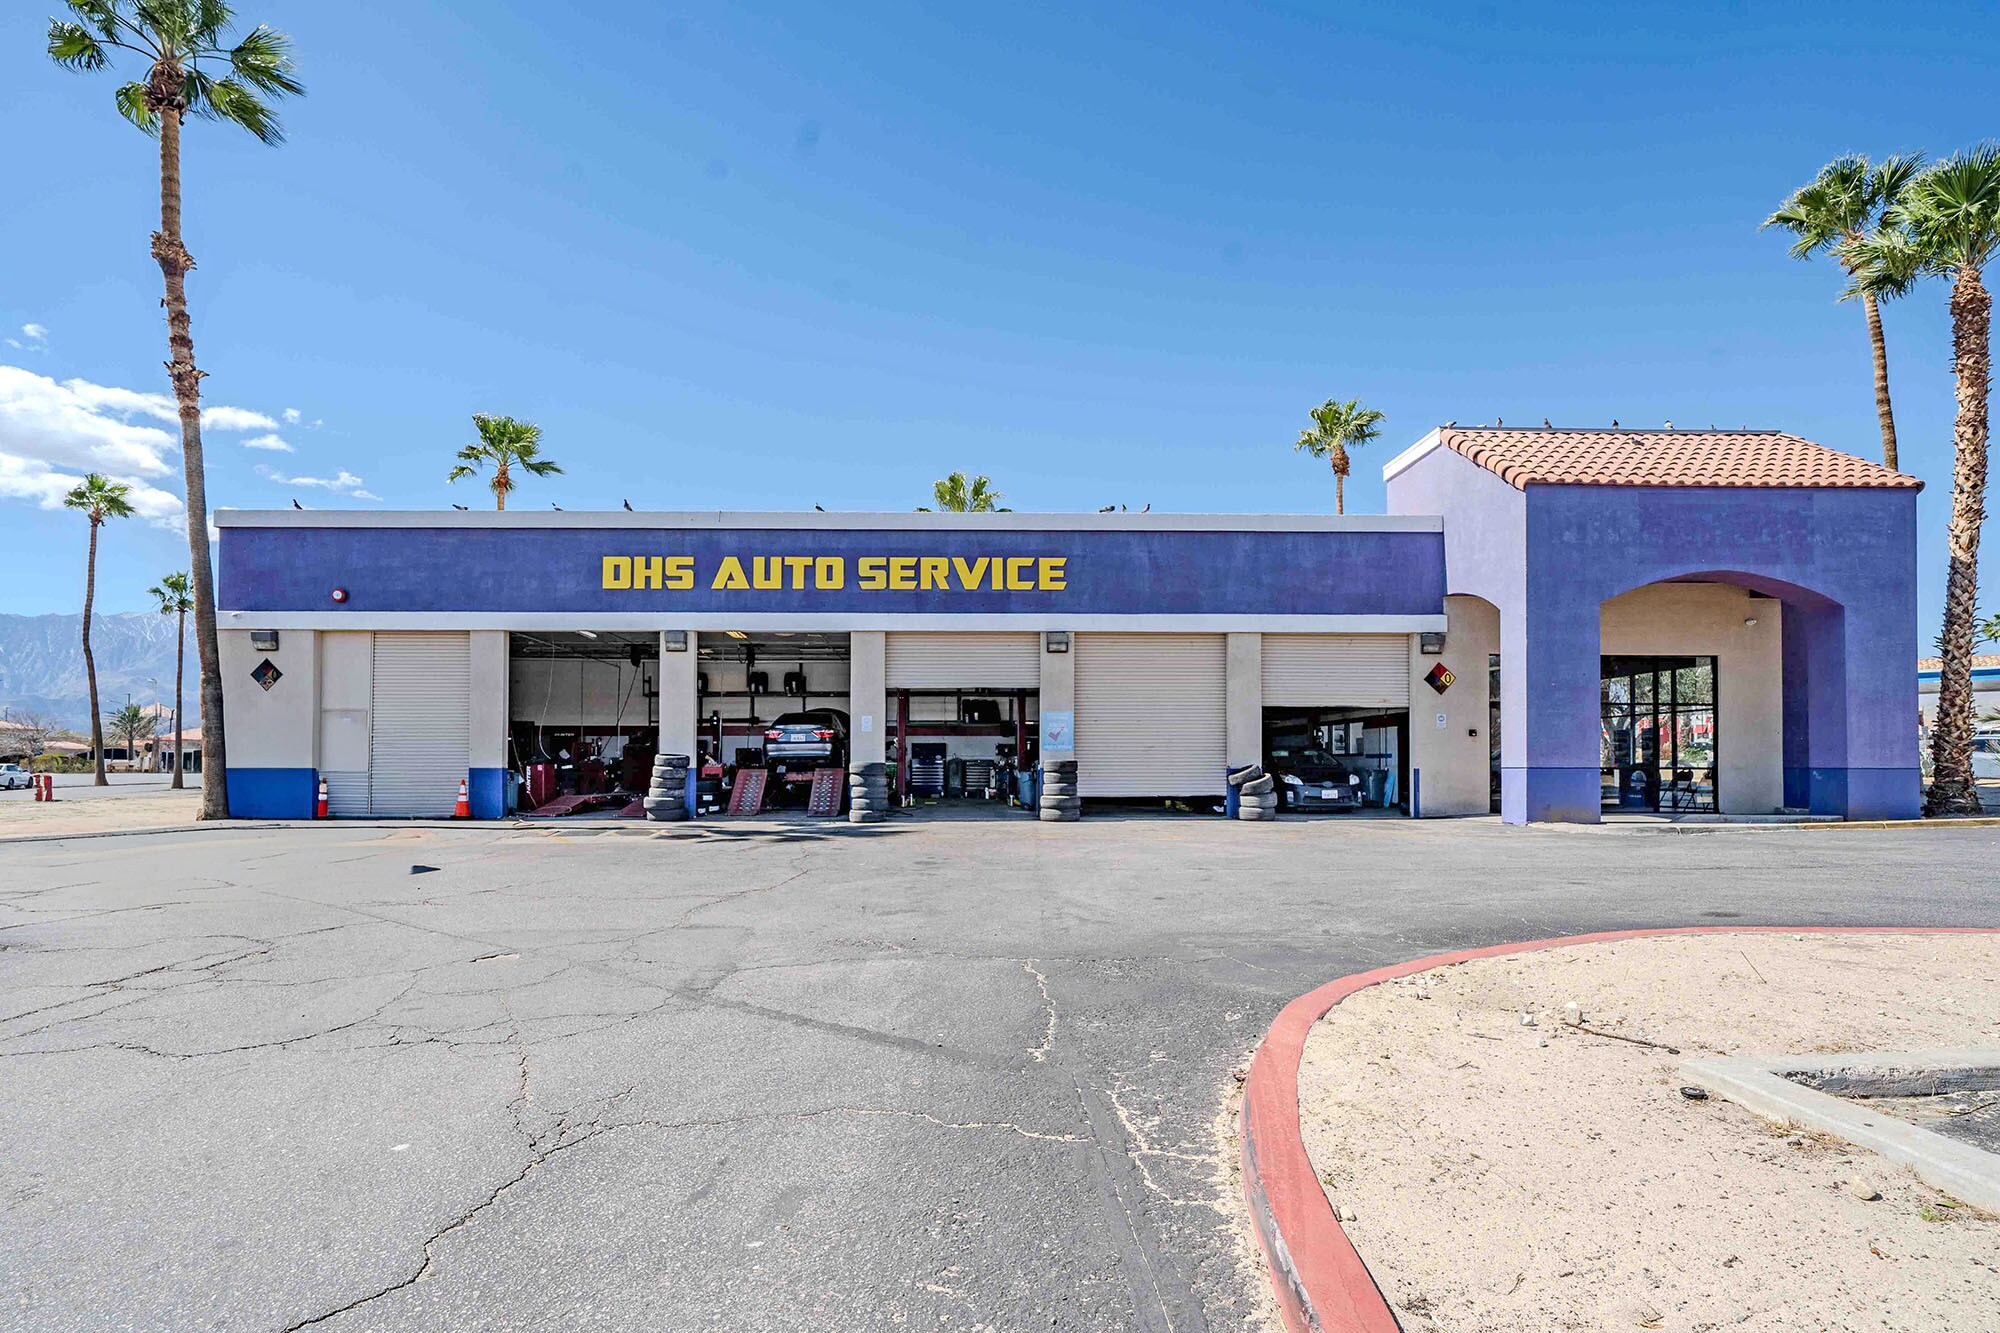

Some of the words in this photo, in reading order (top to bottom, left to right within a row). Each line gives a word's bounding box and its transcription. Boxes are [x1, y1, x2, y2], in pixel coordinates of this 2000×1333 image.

[602, 556, 695, 590] DHS
[711, 556, 845, 590] AUTO
[858, 556, 1068, 591] SERVICE
